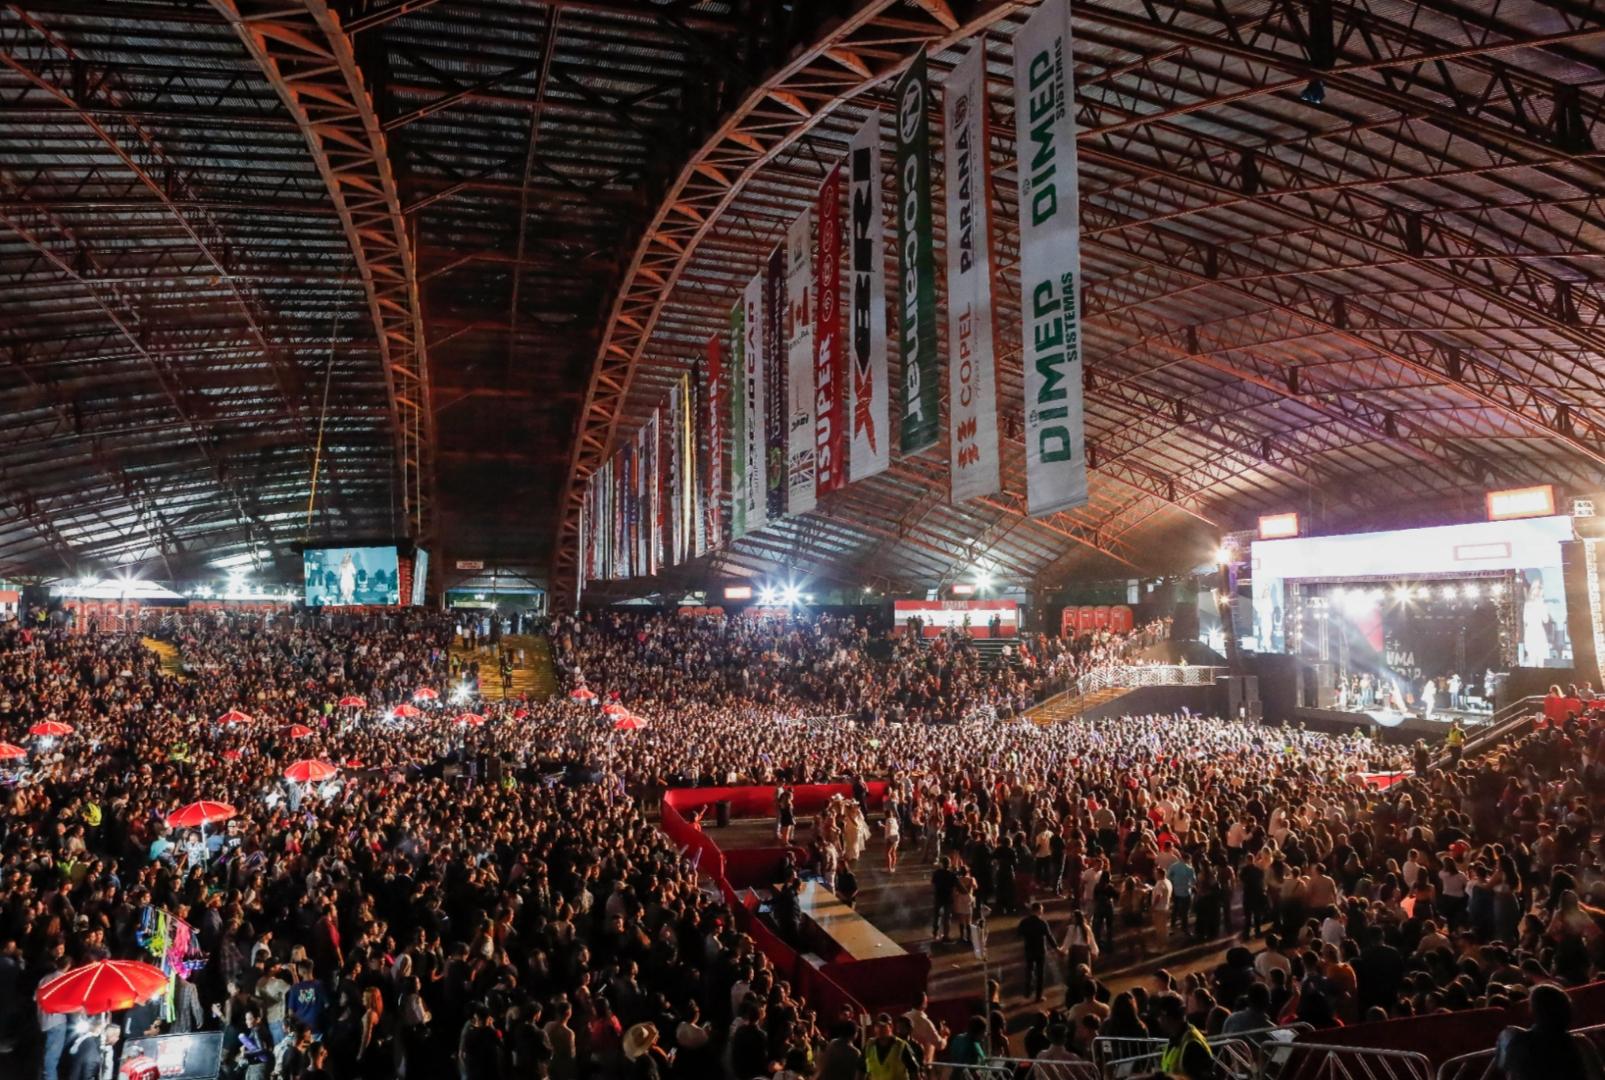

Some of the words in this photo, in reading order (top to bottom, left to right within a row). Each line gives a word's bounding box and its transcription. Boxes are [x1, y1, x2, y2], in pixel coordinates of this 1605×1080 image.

[1029, 49, 1057, 227] DIMEP
[1055, 36, 1065, 120] SISTEMAS
[904, 154, 924, 422] cocamar
[959, 302, 973, 407] COPEL
[1061, 271, 1078, 362] SISTEMAS
[1034, 279, 1071, 463] DIMEP
